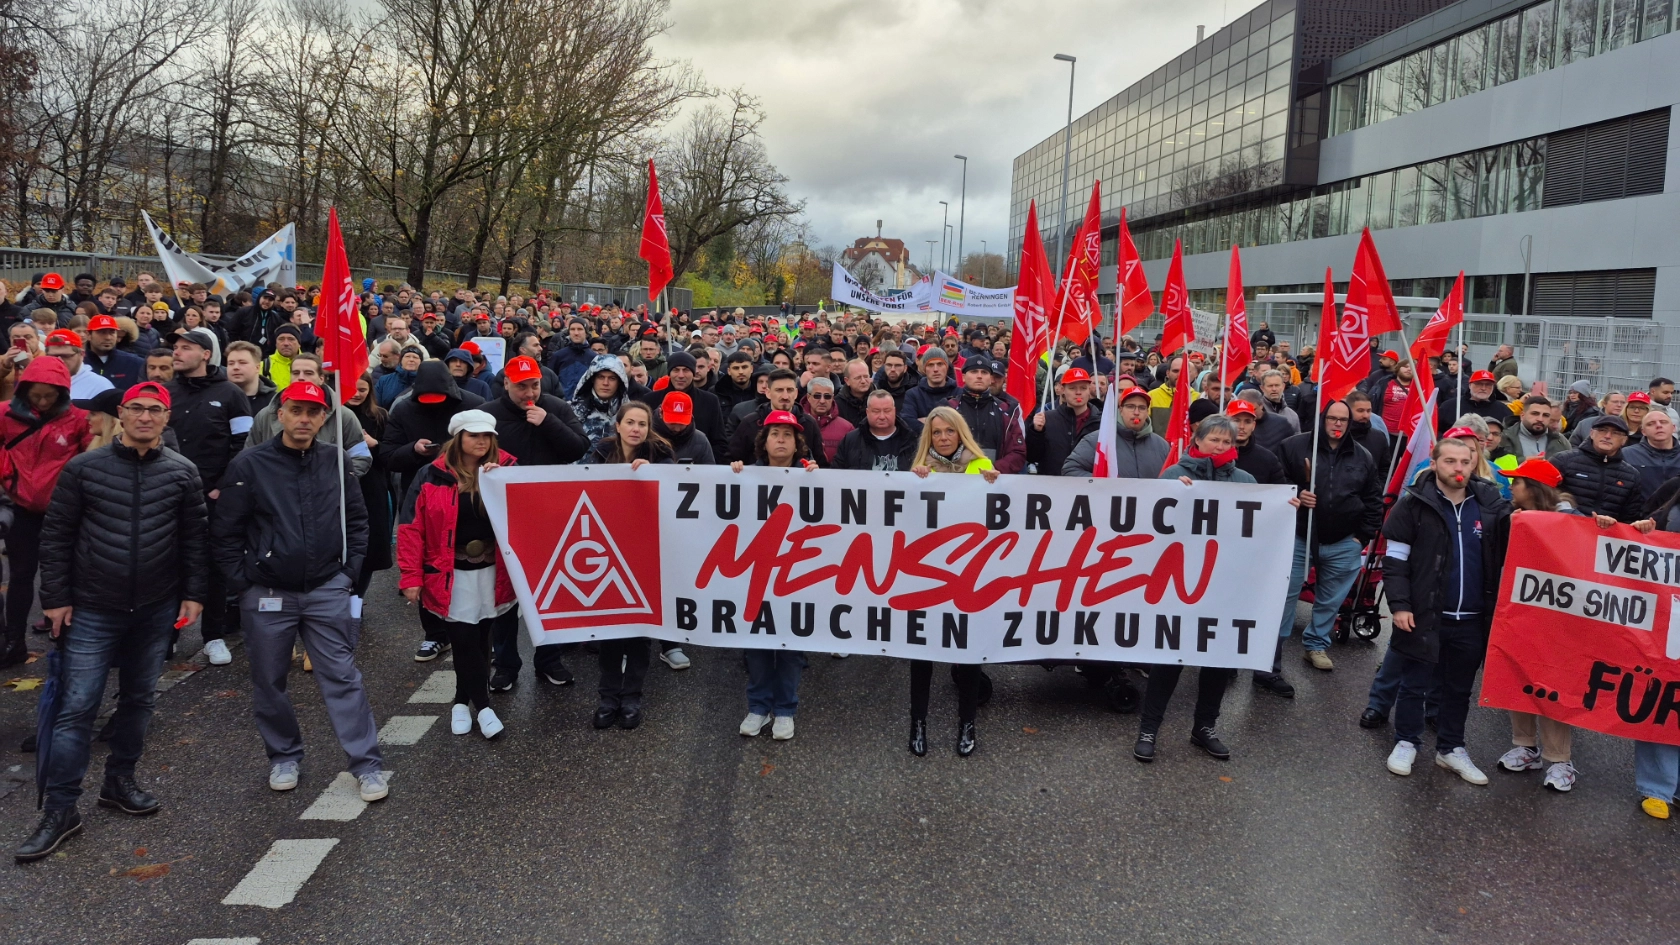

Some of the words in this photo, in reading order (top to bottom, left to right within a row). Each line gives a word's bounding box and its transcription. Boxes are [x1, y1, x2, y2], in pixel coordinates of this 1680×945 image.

[850, 290, 880, 306] UNSERE
[897, 291, 913, 302] FÜR
[675, 483, 945, 529] ZUKUNFT
[985, 492, 1262, 538] BRAUCHT
[695, 503, 1219, 622] MENSCHEN
[676, 597, 969, 649] BRAUCHEN
[1002, 610, 1256, 655] ZUKUNFT
[1519, 573, 1576, 609] DAS
[1583, 589, 1647, 626] SIND
[1582, 660, 1680, 730] FÜR
